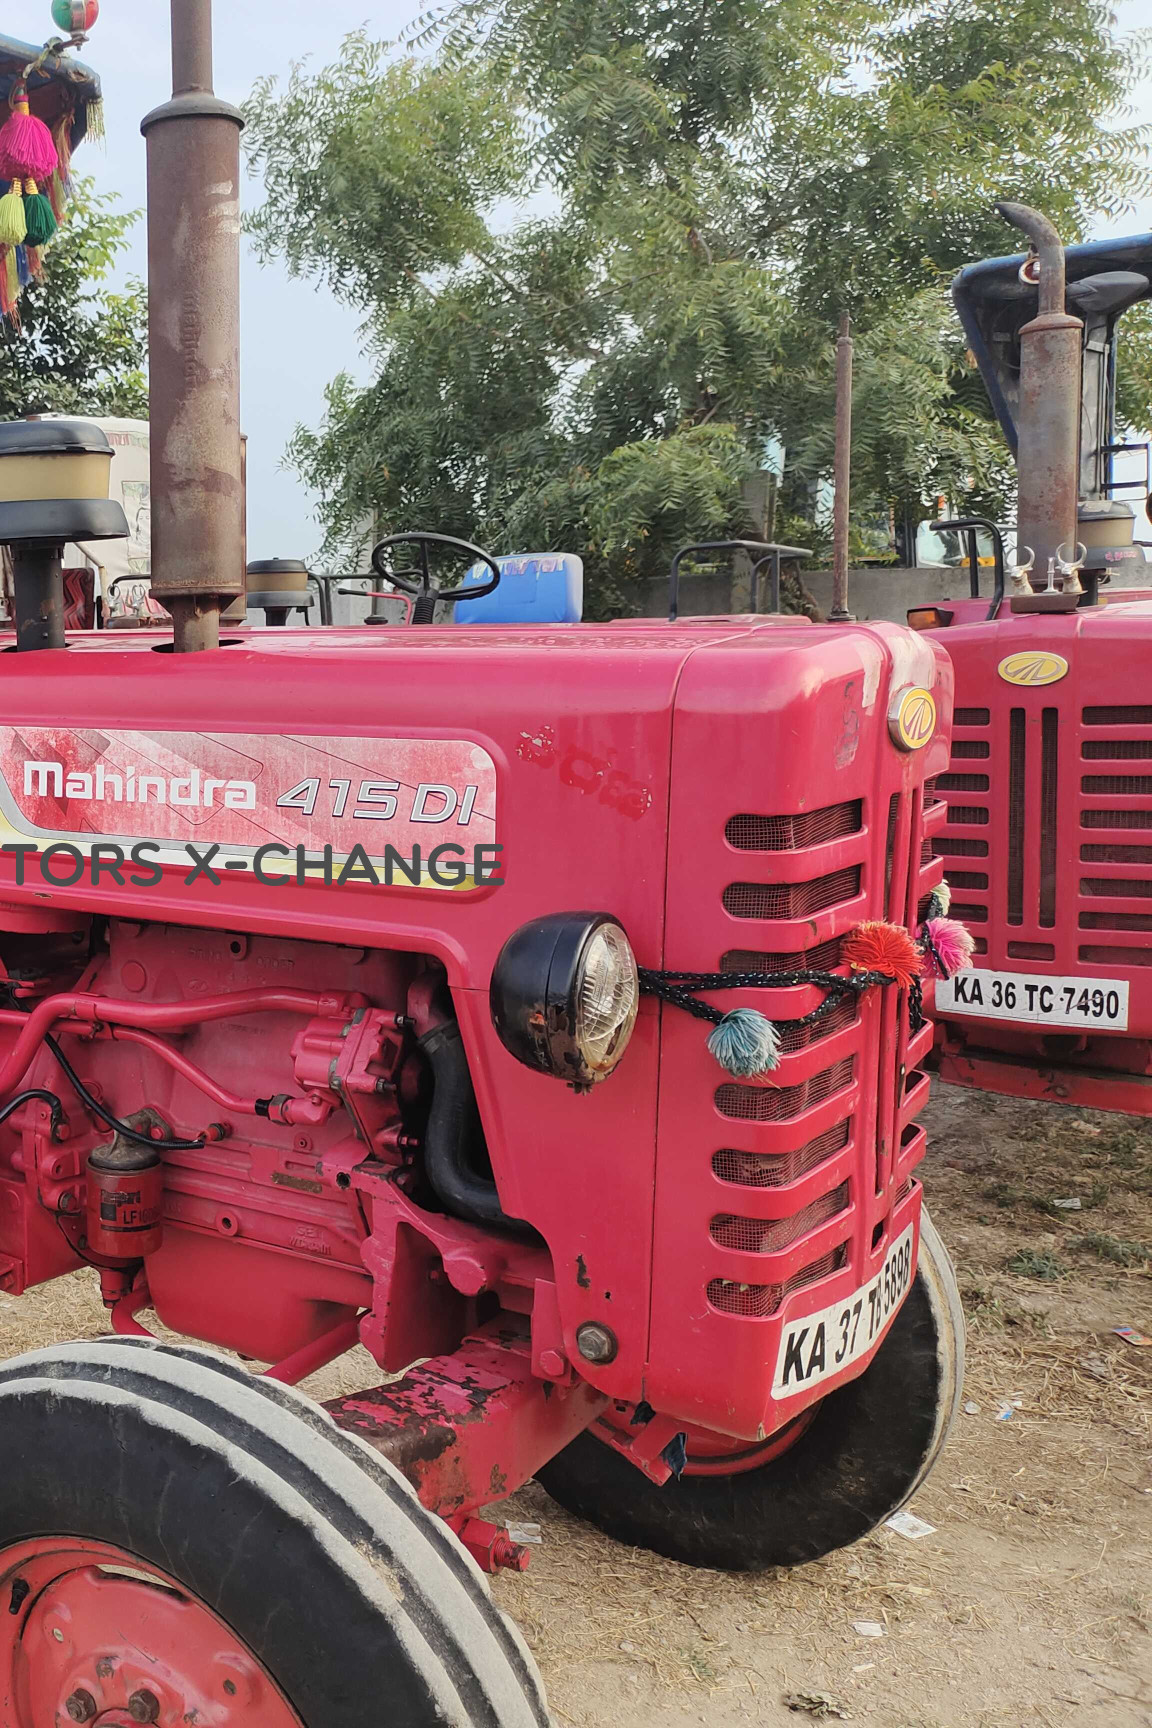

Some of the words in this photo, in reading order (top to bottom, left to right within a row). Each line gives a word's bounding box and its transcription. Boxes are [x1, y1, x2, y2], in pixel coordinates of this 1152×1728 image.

[24, 760, 257, 810] Mahindra
[276, 777, 401, 821] 415
[408, 783, 478, 825] DI
[954, 976, 984, 1006] KA
[991, 980, 1016, 1009] 36
[1024, 984, 1054, 1013] TC
[1062, 987, 1119, 1019] 7490
[782, 1322, 825, 1386] KA
[835, 1299, 862, 1363] 37
